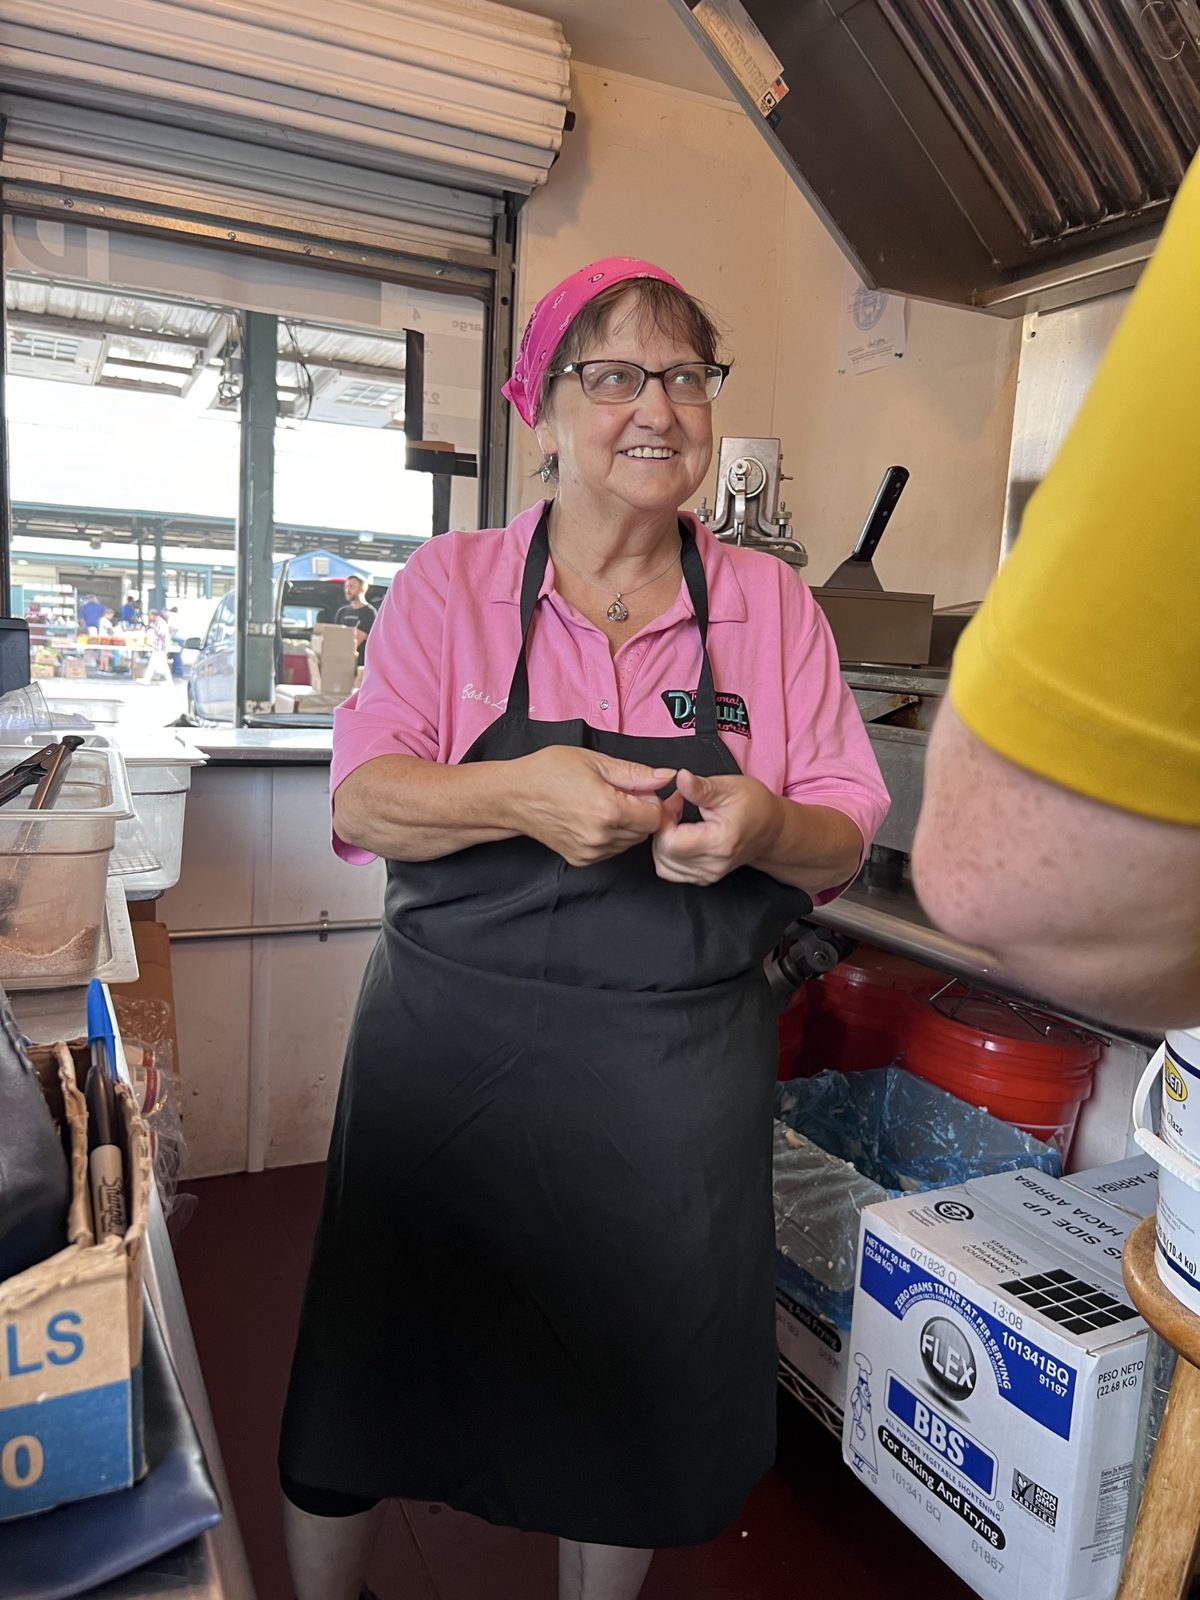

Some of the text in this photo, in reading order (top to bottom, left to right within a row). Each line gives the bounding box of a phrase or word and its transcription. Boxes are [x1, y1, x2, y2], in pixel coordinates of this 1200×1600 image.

[1014, 1174, 1072, 1207] ARRIBA
[1091, 1174, 1147, 1195] ARRIBA
[1022, 1201, 1052, 1217] UP
[1072, 1207, 1124, 1237] HACIA
[1051, 1217, 1102, 1246] SIDE
[866, 1235, 911, 1274] NET WT 50 LBS
[881, 1257, 895, 1275] KG)
[1184, 1256, 1197, 1277] kg)
[910, 1247, 1023, 1331] 071823 Q 13:08
[894, 1281, 1012, 1390] ZERO GRAMS TRANS FAT PER SERVING
[921, 1333, 975, 1389] FLEX
[1002, 1331, 1070, 1387] 101341BQ
[1097, 1360, 1144, 1384] PESO NETO
[1039, 1373, 1068, 1398] 91197
[1096, 1375, 1138, 1400] (22.68 KG)
[913, 1400, 965, 1467] BBS
[882, 1429, 900, 1453] For
[901, 1447, 934, 1490] Baking
[936, 1481, 961, 1509] And
[963, 1501, 999, 1546] Frying
[896, 1427, 921, 1454] PURPOSE
[922, 1450, 956, 1484] VEGETABLE
[957, 1480, 1001, 1522] SHORTENING
[891, 1468, 942, 1522] 101341 BQ
[1013, 1491, 1054, 1525] VERIFIED
[1035, 1494, 1056, 1511] GMO
[1036, 1486, 1057, 1505] NON
[971, 1539, 1006, 1575] 01867
